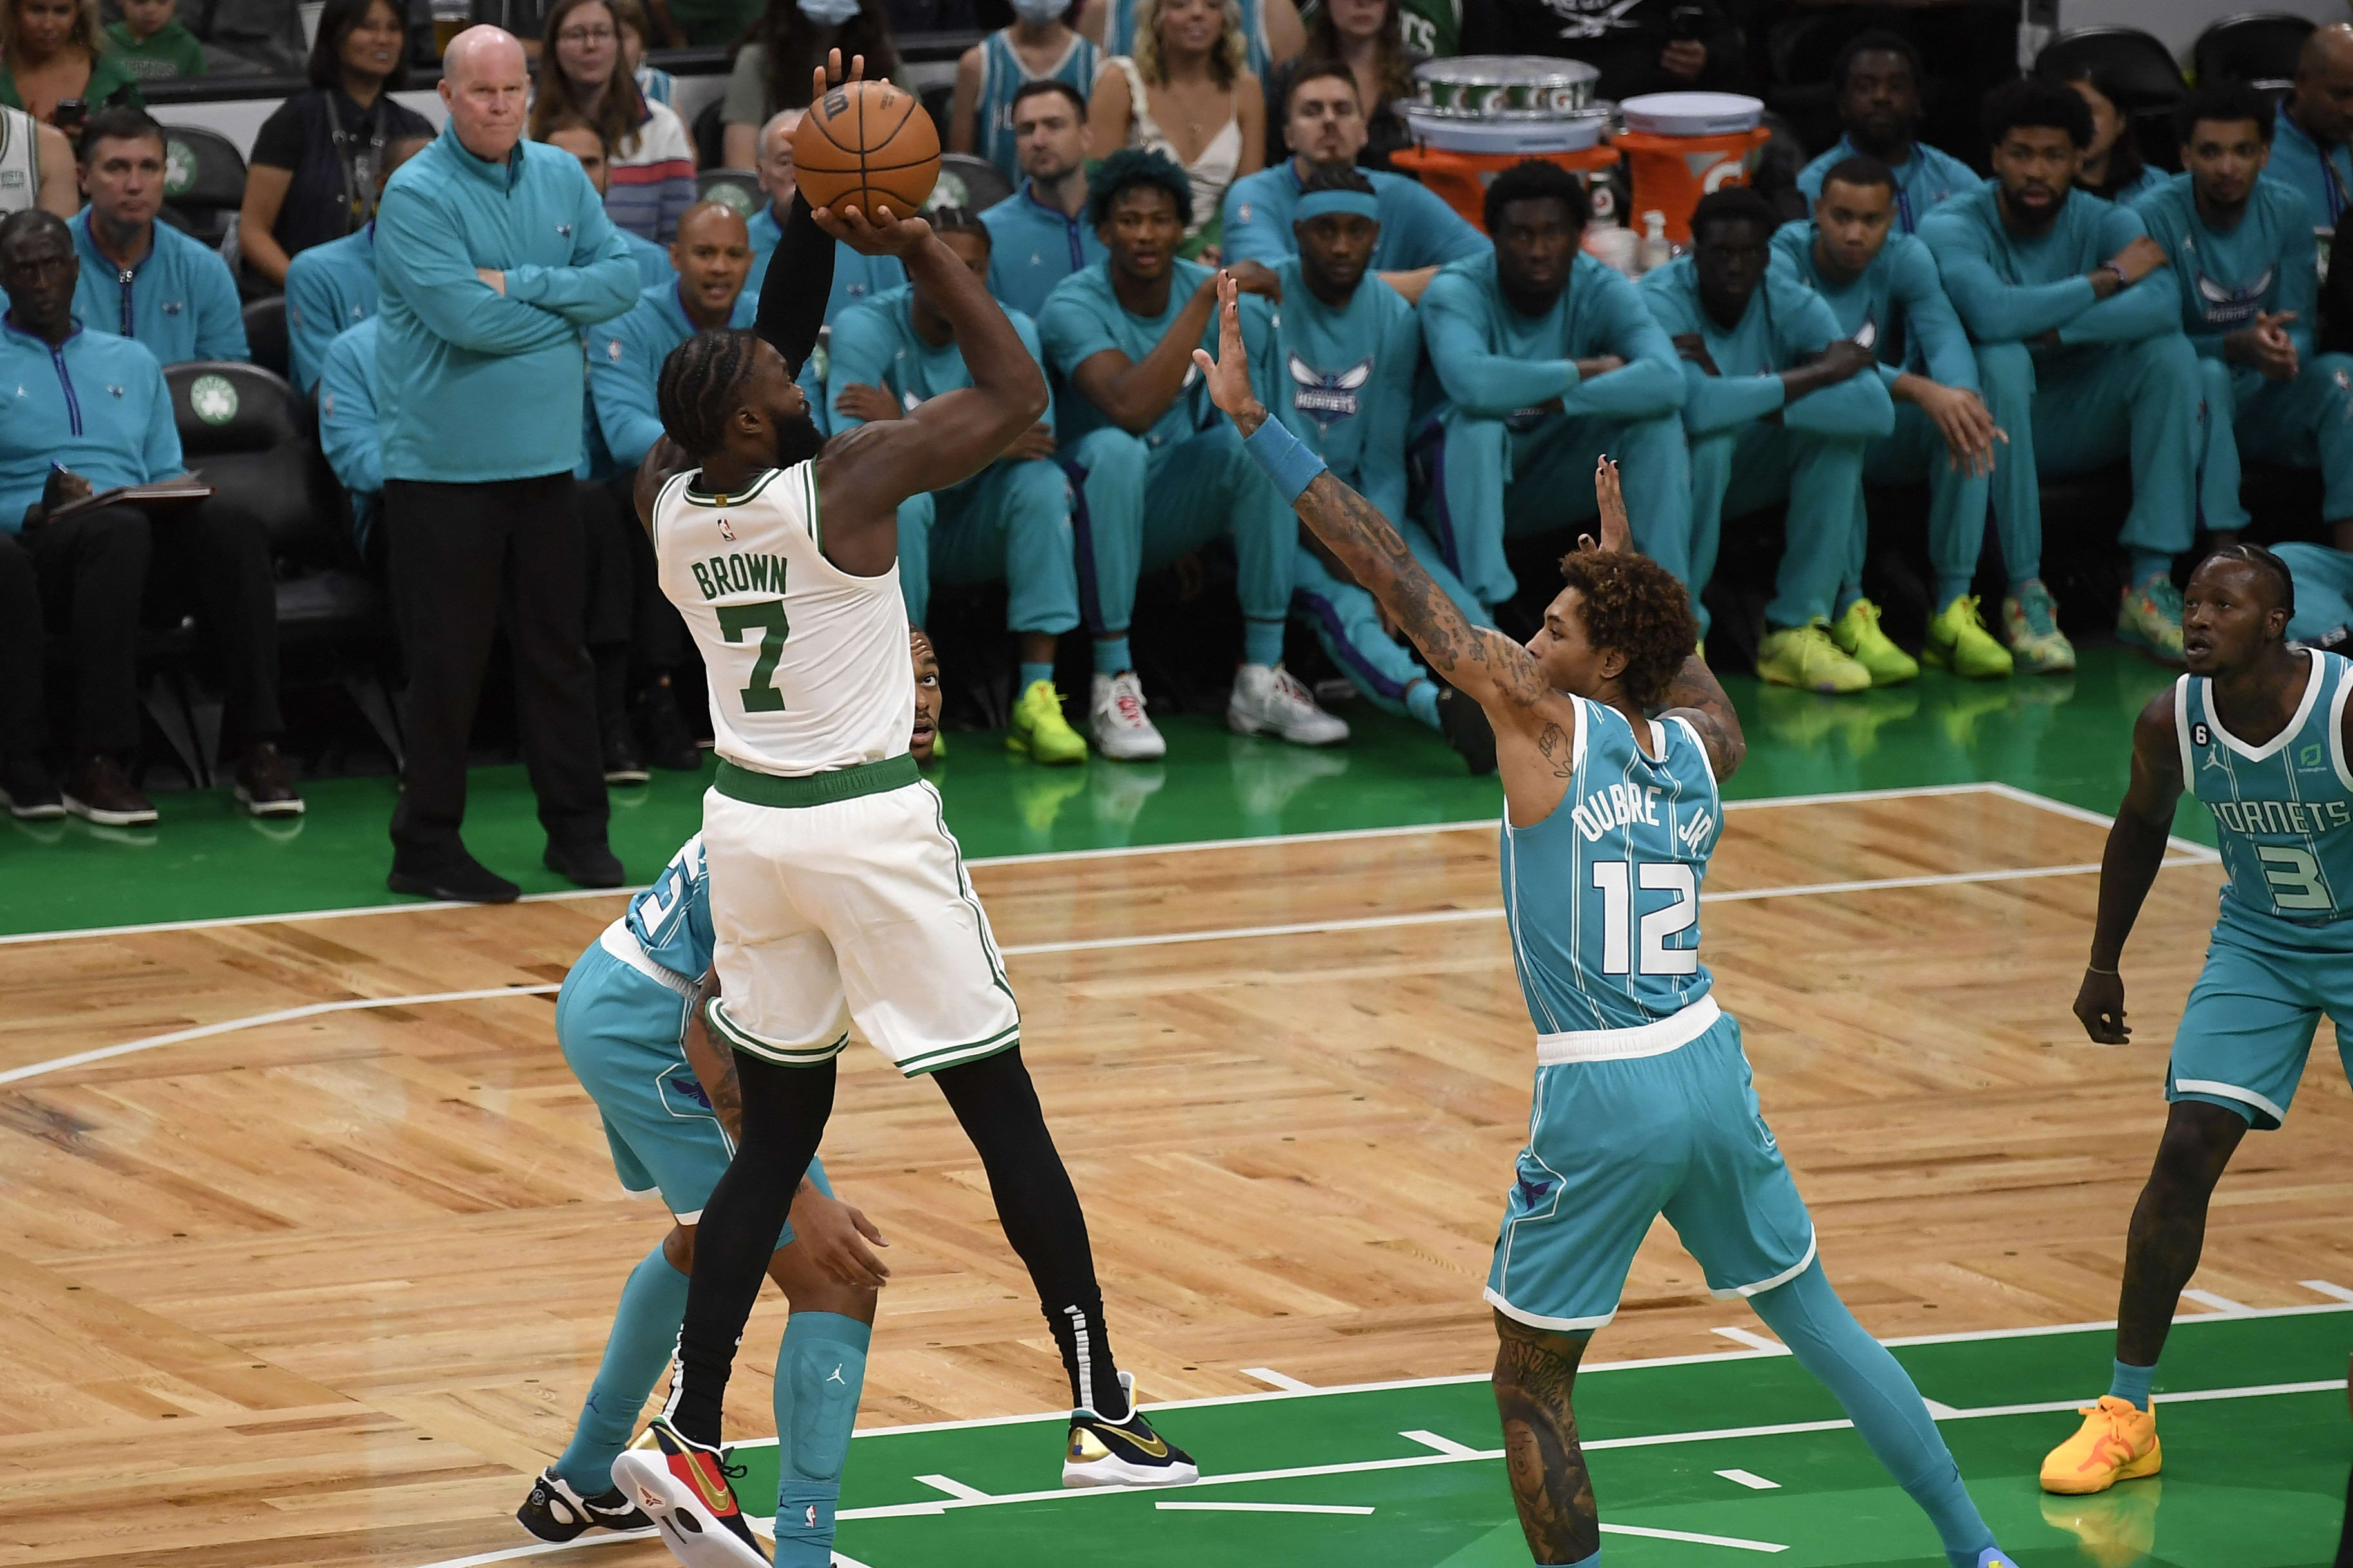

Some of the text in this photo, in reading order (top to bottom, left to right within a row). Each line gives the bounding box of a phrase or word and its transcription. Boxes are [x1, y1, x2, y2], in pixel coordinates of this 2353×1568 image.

[691, 553, 787, 600] BROWN
[715, 600, 790, 713] 7
[2196, 726, 2207, 744] 6
[1572, 783, 1662, 842] OUBRE
[2258, 845, 2332, 909] 3
[1592, 860, 1698, 976] 12
